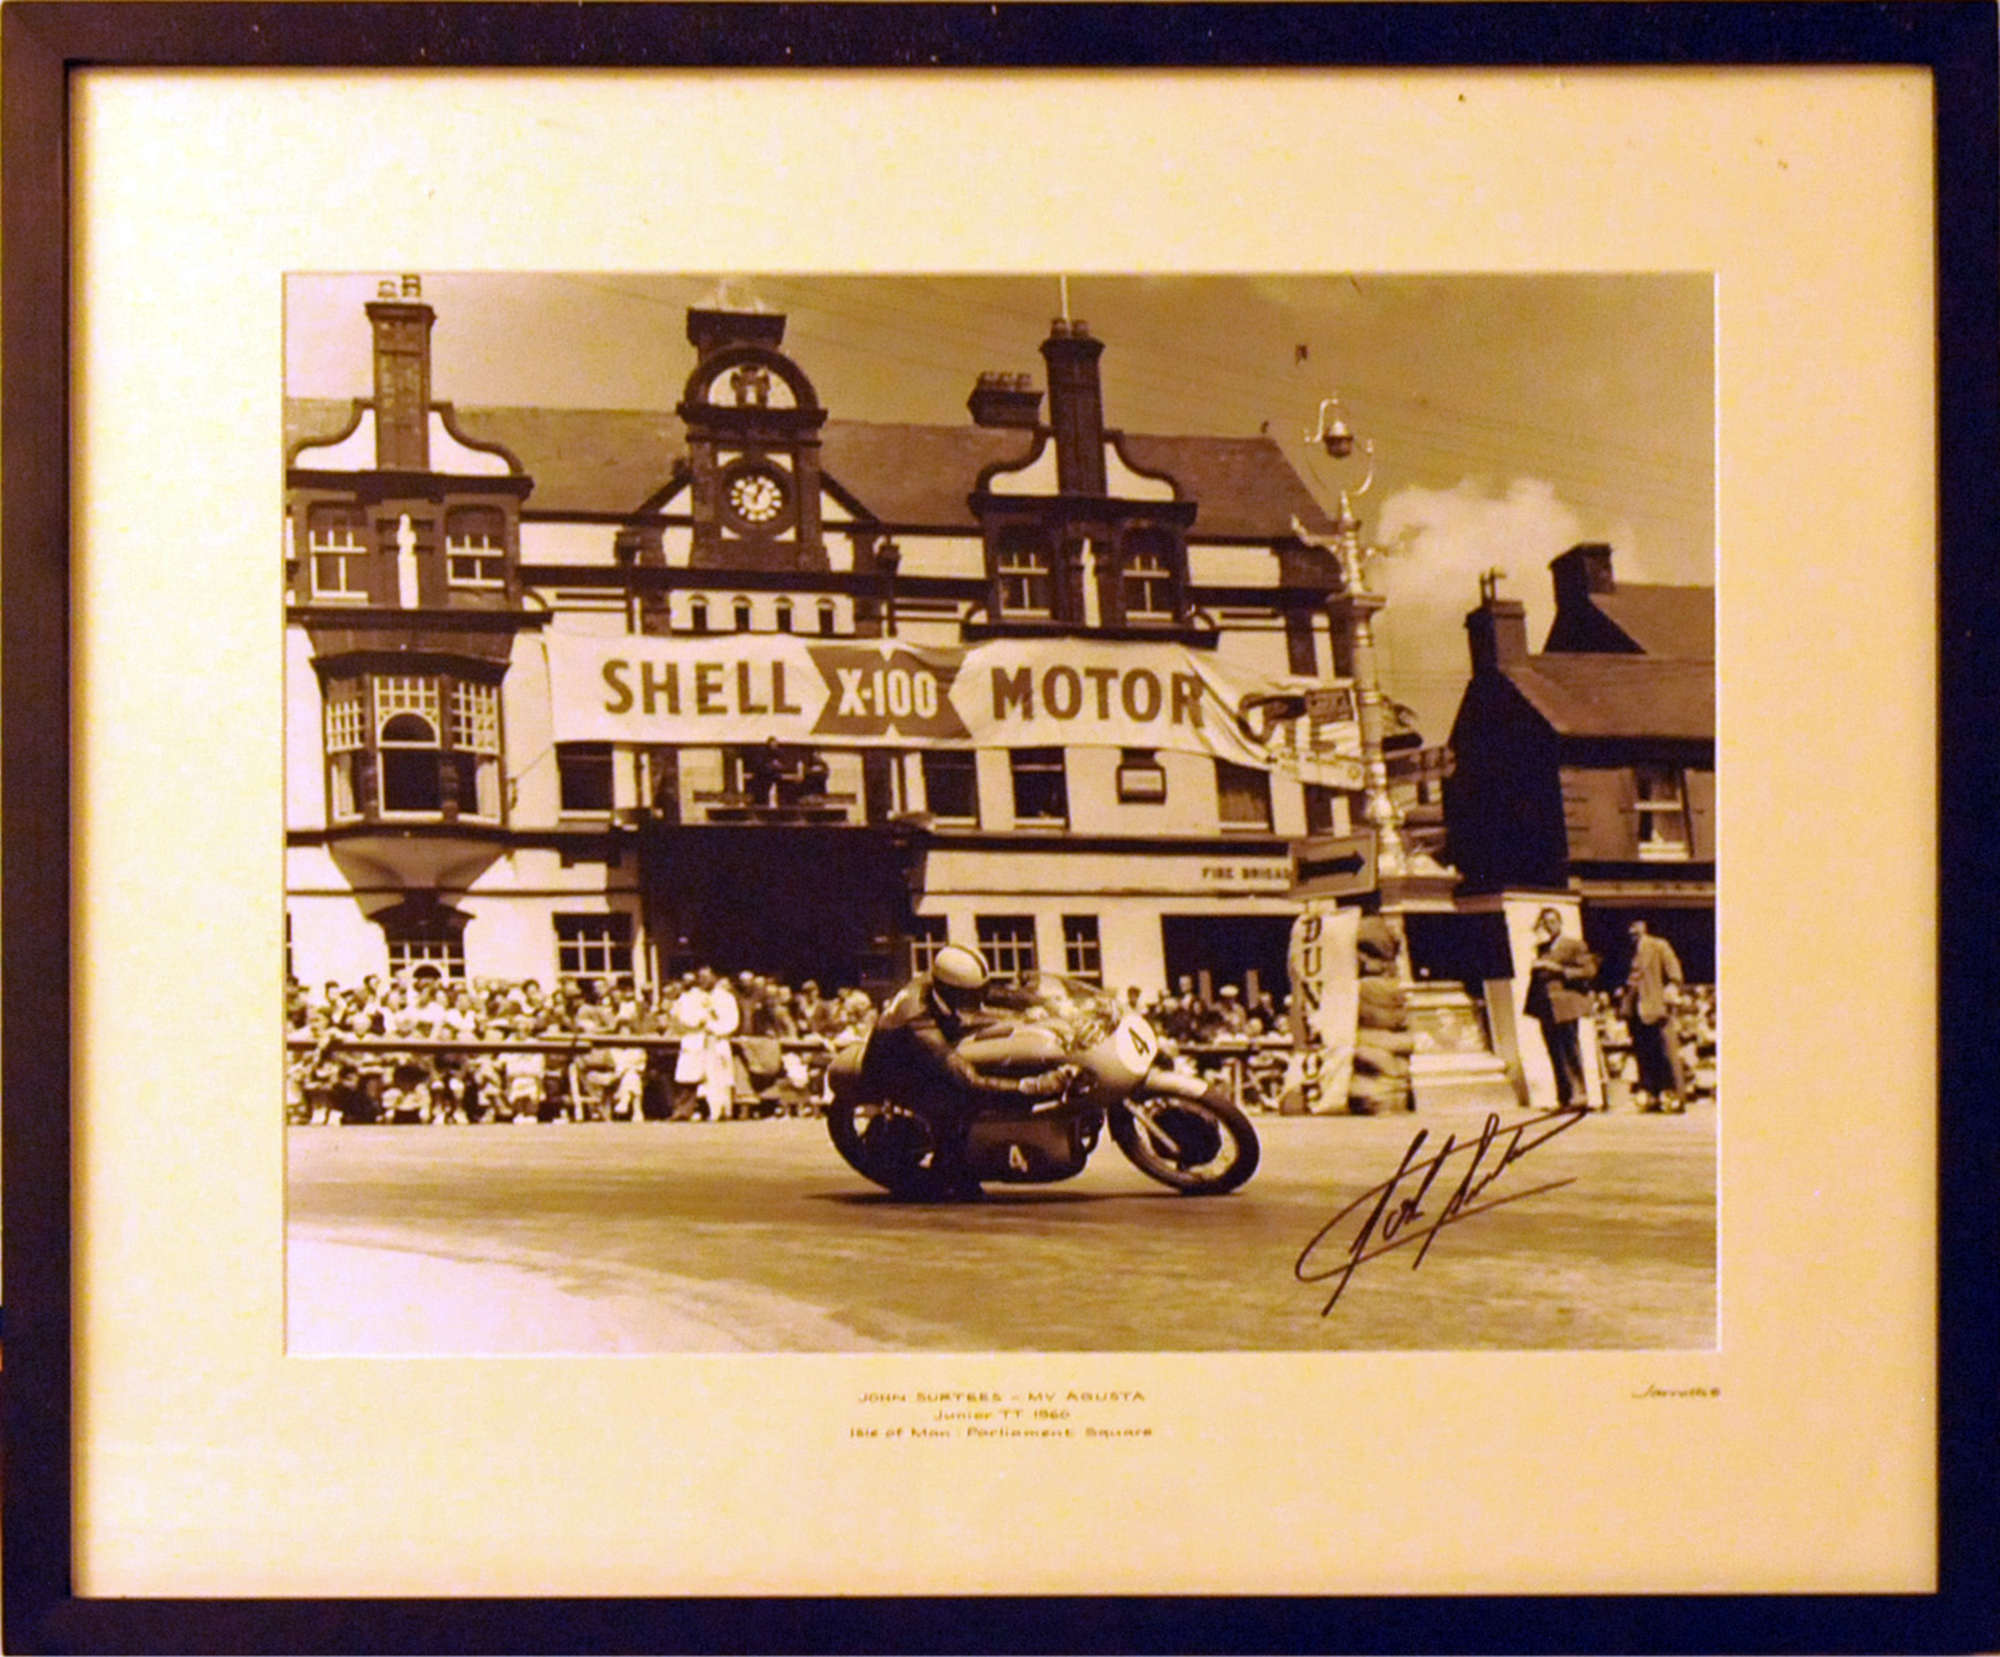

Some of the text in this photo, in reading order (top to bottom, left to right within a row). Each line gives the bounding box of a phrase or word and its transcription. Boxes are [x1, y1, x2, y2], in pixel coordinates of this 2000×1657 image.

[602, 660, 1206, 728] SHELL X-100 MOTOR
[1128, 1026, 1150, 1056] 4
[1009, 1144, 1028, 1173] 4
[858, 1391, 906, 1402] JOHN
[916, 1391, 1002, 1402] SURTEES
[1028, 1391, 1055, 1402] MV
[934, 1408, 993, 1421] Junior
[1000, 1409, 1023, 1420] TT
[849, 1426, 1153, 1440] Isle of Man Parliament Square
